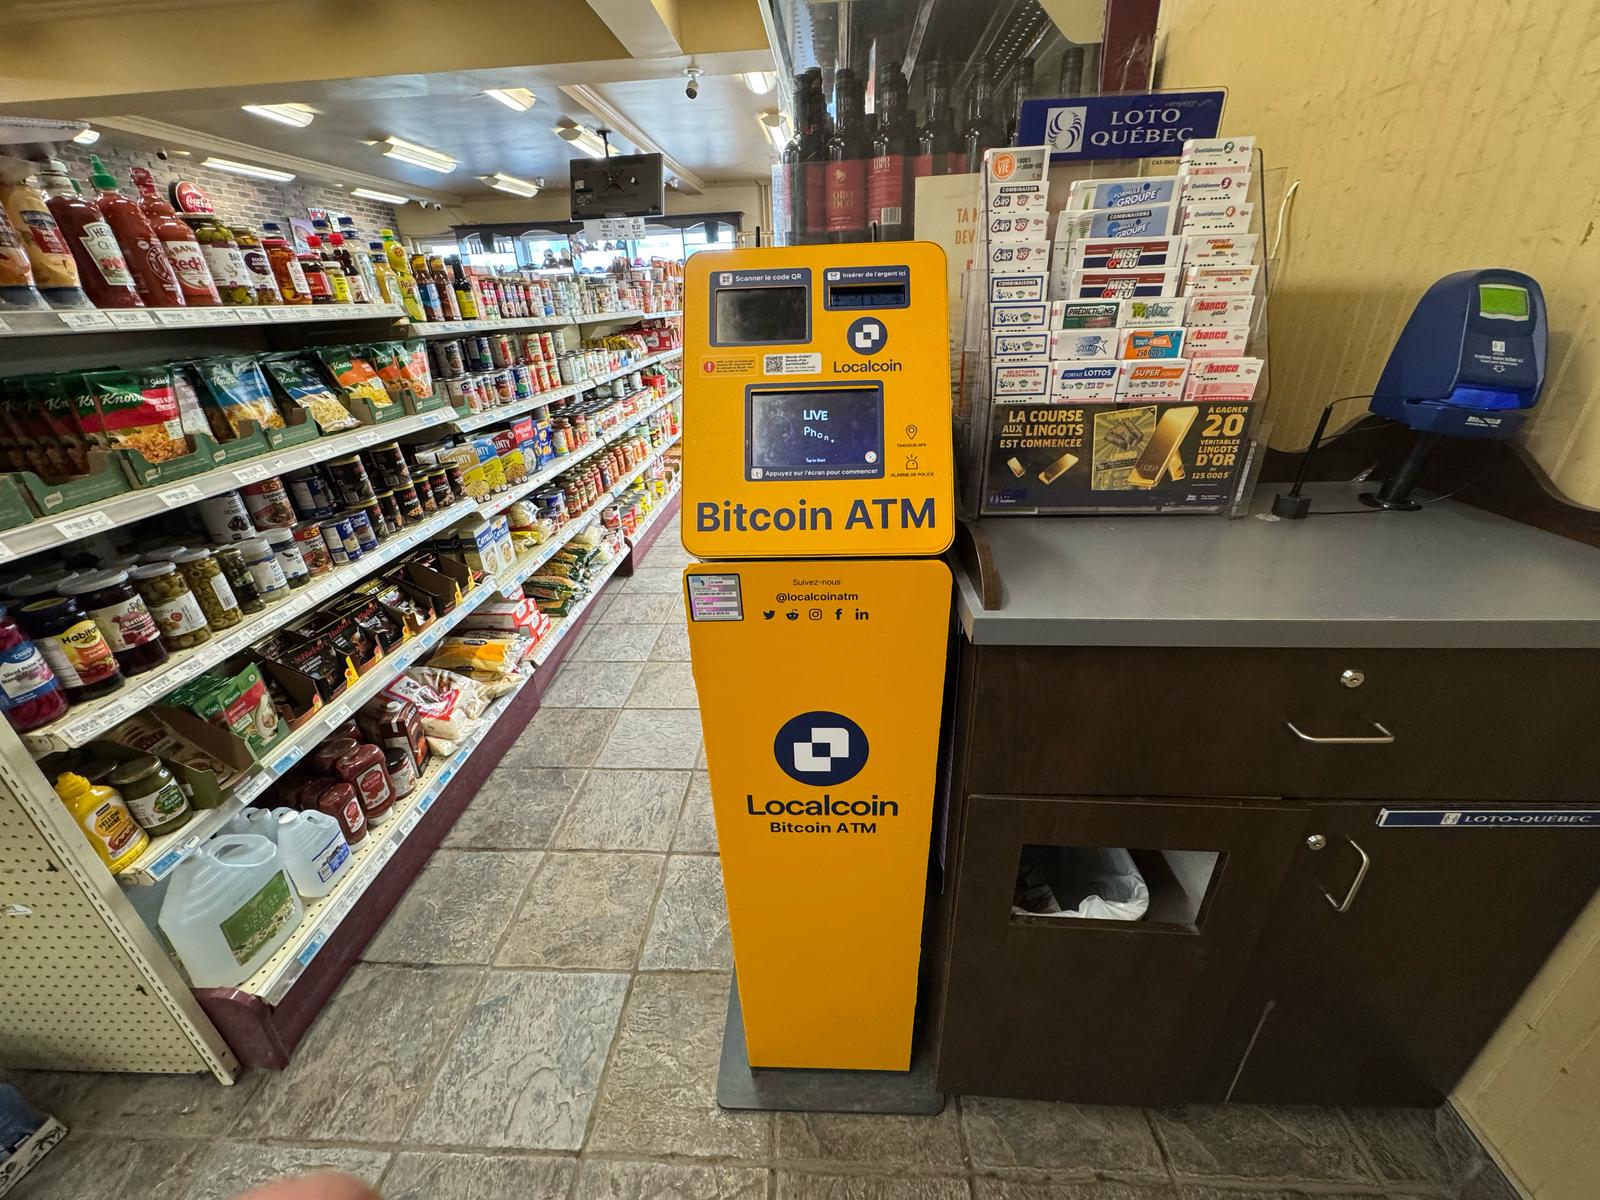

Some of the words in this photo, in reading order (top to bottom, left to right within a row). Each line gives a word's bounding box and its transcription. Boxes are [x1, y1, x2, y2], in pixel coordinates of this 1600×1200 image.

[1110, 108, 1181, 125] LOTO
[1090, 126, 1194, 146] QUÉBEC
[1116, 190, 1157, 207] GROUPE
[957, 208, 969, 223] TA
[1109, 210, 1151, 220] COMBINAISONS
[1115, 223, 1147, 238] GROUPE
[1112, 248, 1142, 259] MISE
[736, 274, 764, 282] Scanner
[764, 273, 771, 281] le
[772, 273, 790, 281] code
[874, 270, 898, 278] l'argent
[1107, 279, 1137, 290] MISE
[1067, 305, 1116, 316] PRÉDICTIONS
[1198, 300, 1228, 311] banco
[1195, 330, 1228, 340] banco
[1077, 343, 1098, 353] Astro
[331, 360, 353, 371] Knorr
[833, 359, 902, 374] Localcoin
[1206, 363, 1239, 373] banco
[1083, 369, 1112, 377] LOTTOS
[1135, 369, 1161, 377] SUPER
[99, 391, 146, 406] Knorr
[803, 409, 829, 421] LIVE
[1216, 406, 1249, 414] GAGNER
[1008, 410, 1026, 423] LA
[1029, 409, 1084, 423] COURSE
[1002, 425, 1023, 433] AUX
[1025, 423, 1084, 437] LINGOTS
[1202, 413, 1245, 437] 20
[999, 439, 1019, 448] EST
[1198, 445, 1239, 454] LINGOTS
[696, 499, 832, 533] Bitcoin
[844, 498, 936, 530] ATM
[793, 578, 841, 586] Suivez-nous
[776, 592, 859, 603] @localcoinatm
[746, 794, 899, 816] Localcoin
[98, 809, 120, 829] YELLOW
[104, 816, 121, 832] JAUNE
[1463, 814, 1592, 823] LOTO-QUÉBEC
[770, 821, 831, 833] Bitcoin
[836, 822, 877, 834] ATM
